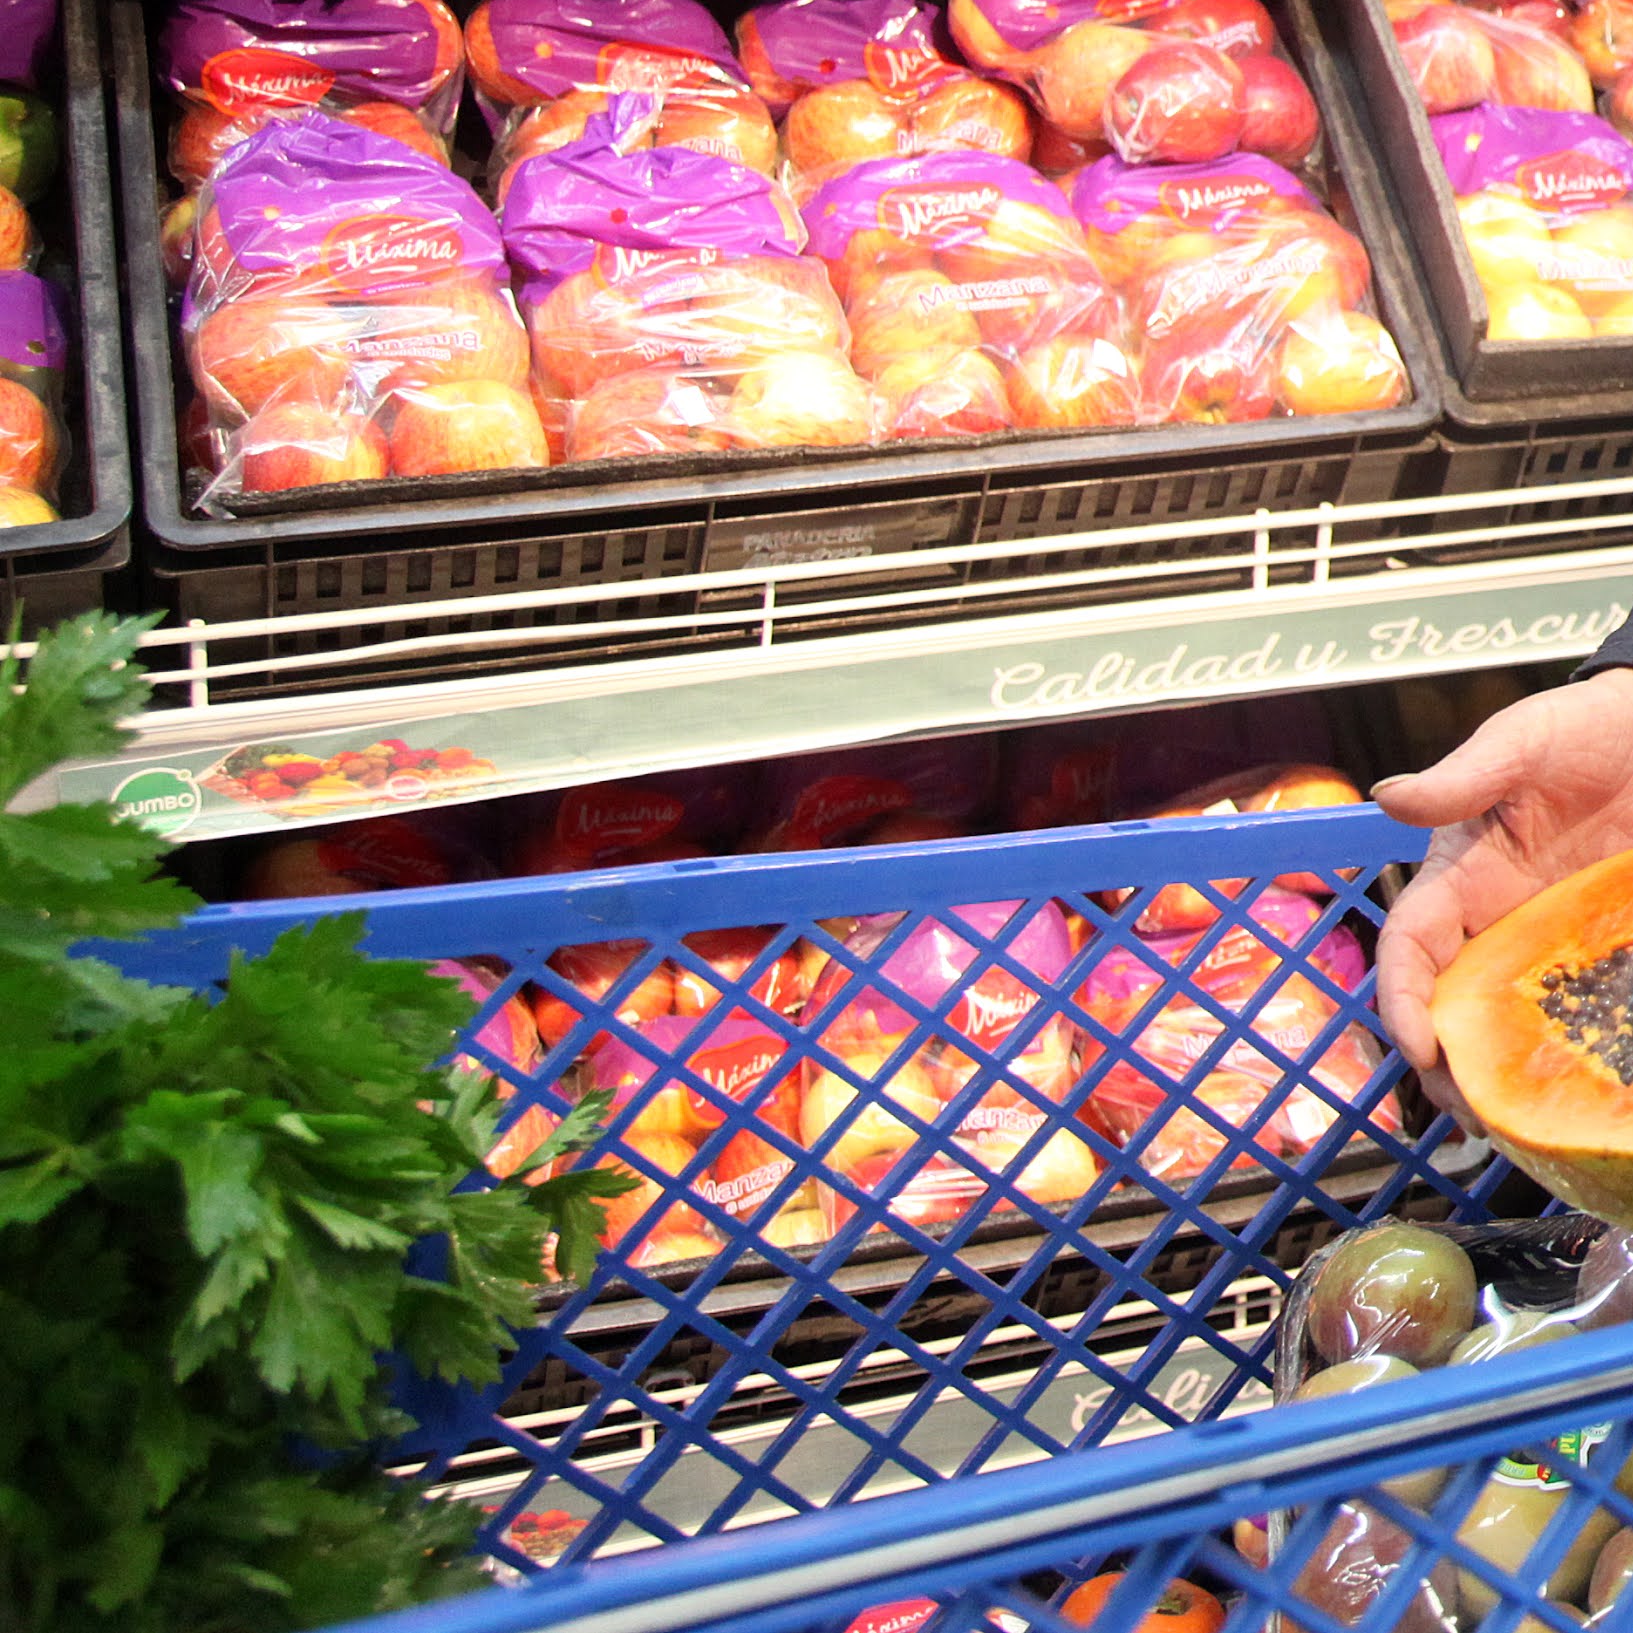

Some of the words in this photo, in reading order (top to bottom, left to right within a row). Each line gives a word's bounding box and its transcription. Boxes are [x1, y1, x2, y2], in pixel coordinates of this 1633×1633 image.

[1533, 170, 1623, 200] Máxima
[917, 275, 1050, 315] Manzana
[988, 631, 1282, 713] Calidad
[1293, 640, 1348, 673] y
[1370, 598, 1629, 665] Frescur
